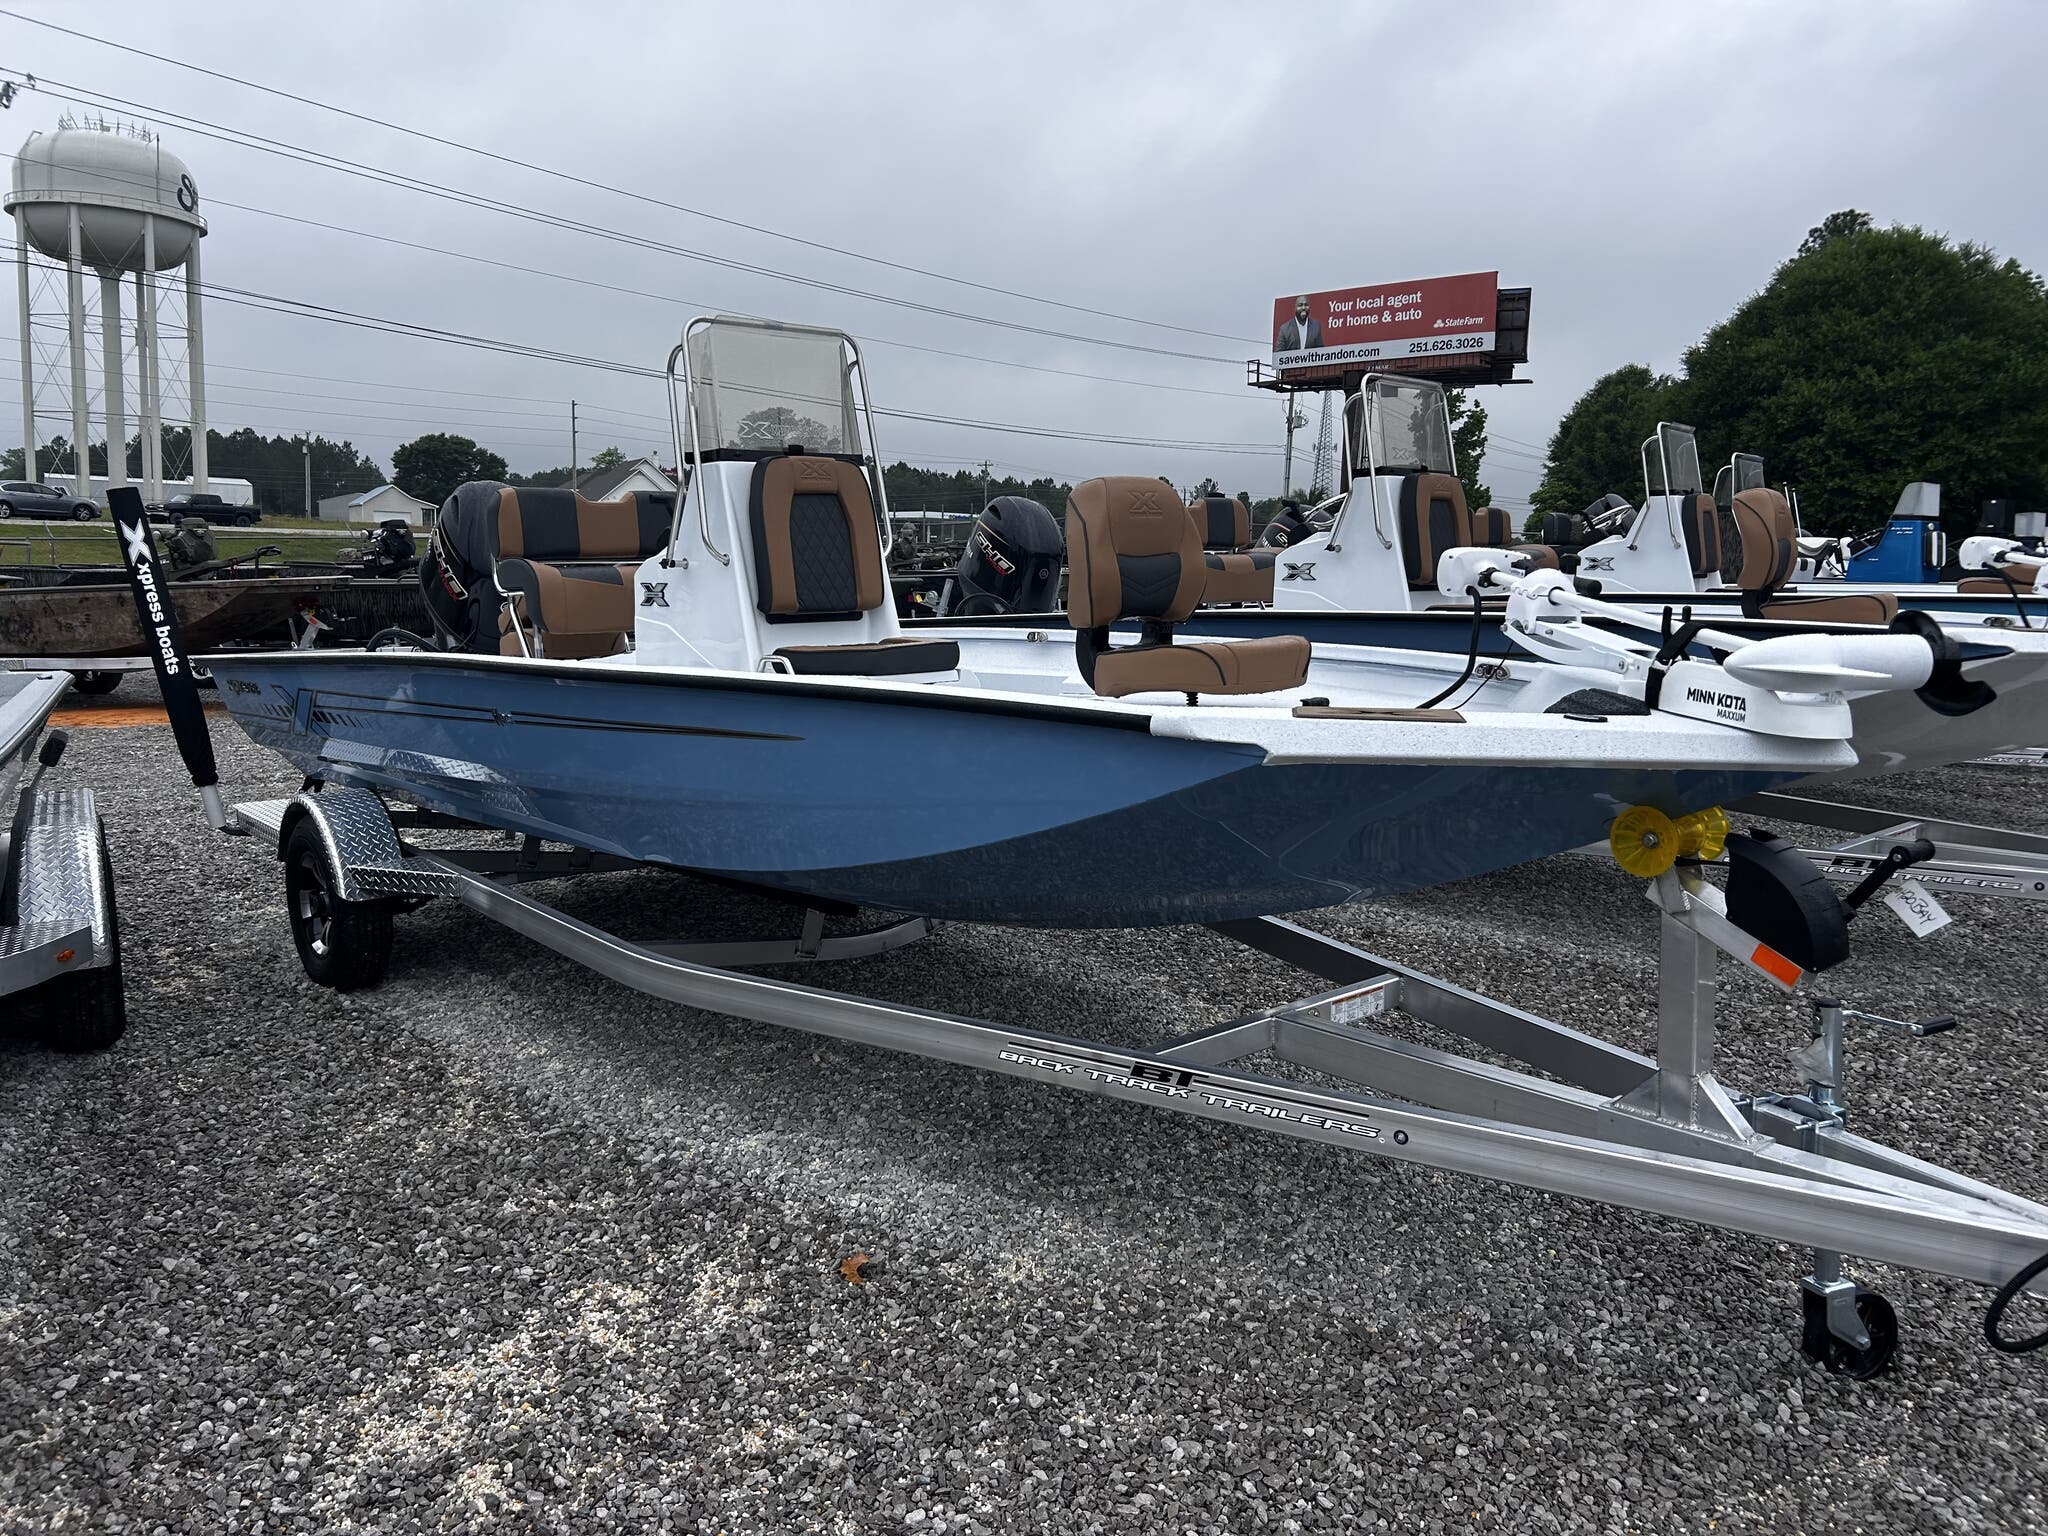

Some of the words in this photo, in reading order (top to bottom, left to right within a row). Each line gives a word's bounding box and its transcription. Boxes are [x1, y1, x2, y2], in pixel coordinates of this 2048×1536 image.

[1328, 300, 1353, 313] Your
[1356, 295, 1384, 310] local
[1387, 291, 1422, 308] agent
[1328, 316, 1344, 329] for
[1346, 313, 1379, 327] home
[1381, 310, 1392, 323] &
[1395, 308, 1422, 322] auto
[1278, 346, 1380, 366] savewithrandon.com
[1409, 337, 1484, 354] 251.626.3026
[136, 562, 164, 623] xpress
[155, 625, 179, 675] boats
[1686, 687, 1716, 704] MINN
[1717, 693, 1746, 712] KOTA
[1716, 708, 1746, 722] MAXXUM
[998, 1050, 1080, 1074] BACK
[1085, 1068, 1196, 1099] TRACK
[1201, 1092, 1381, 1139] TRAILERS
